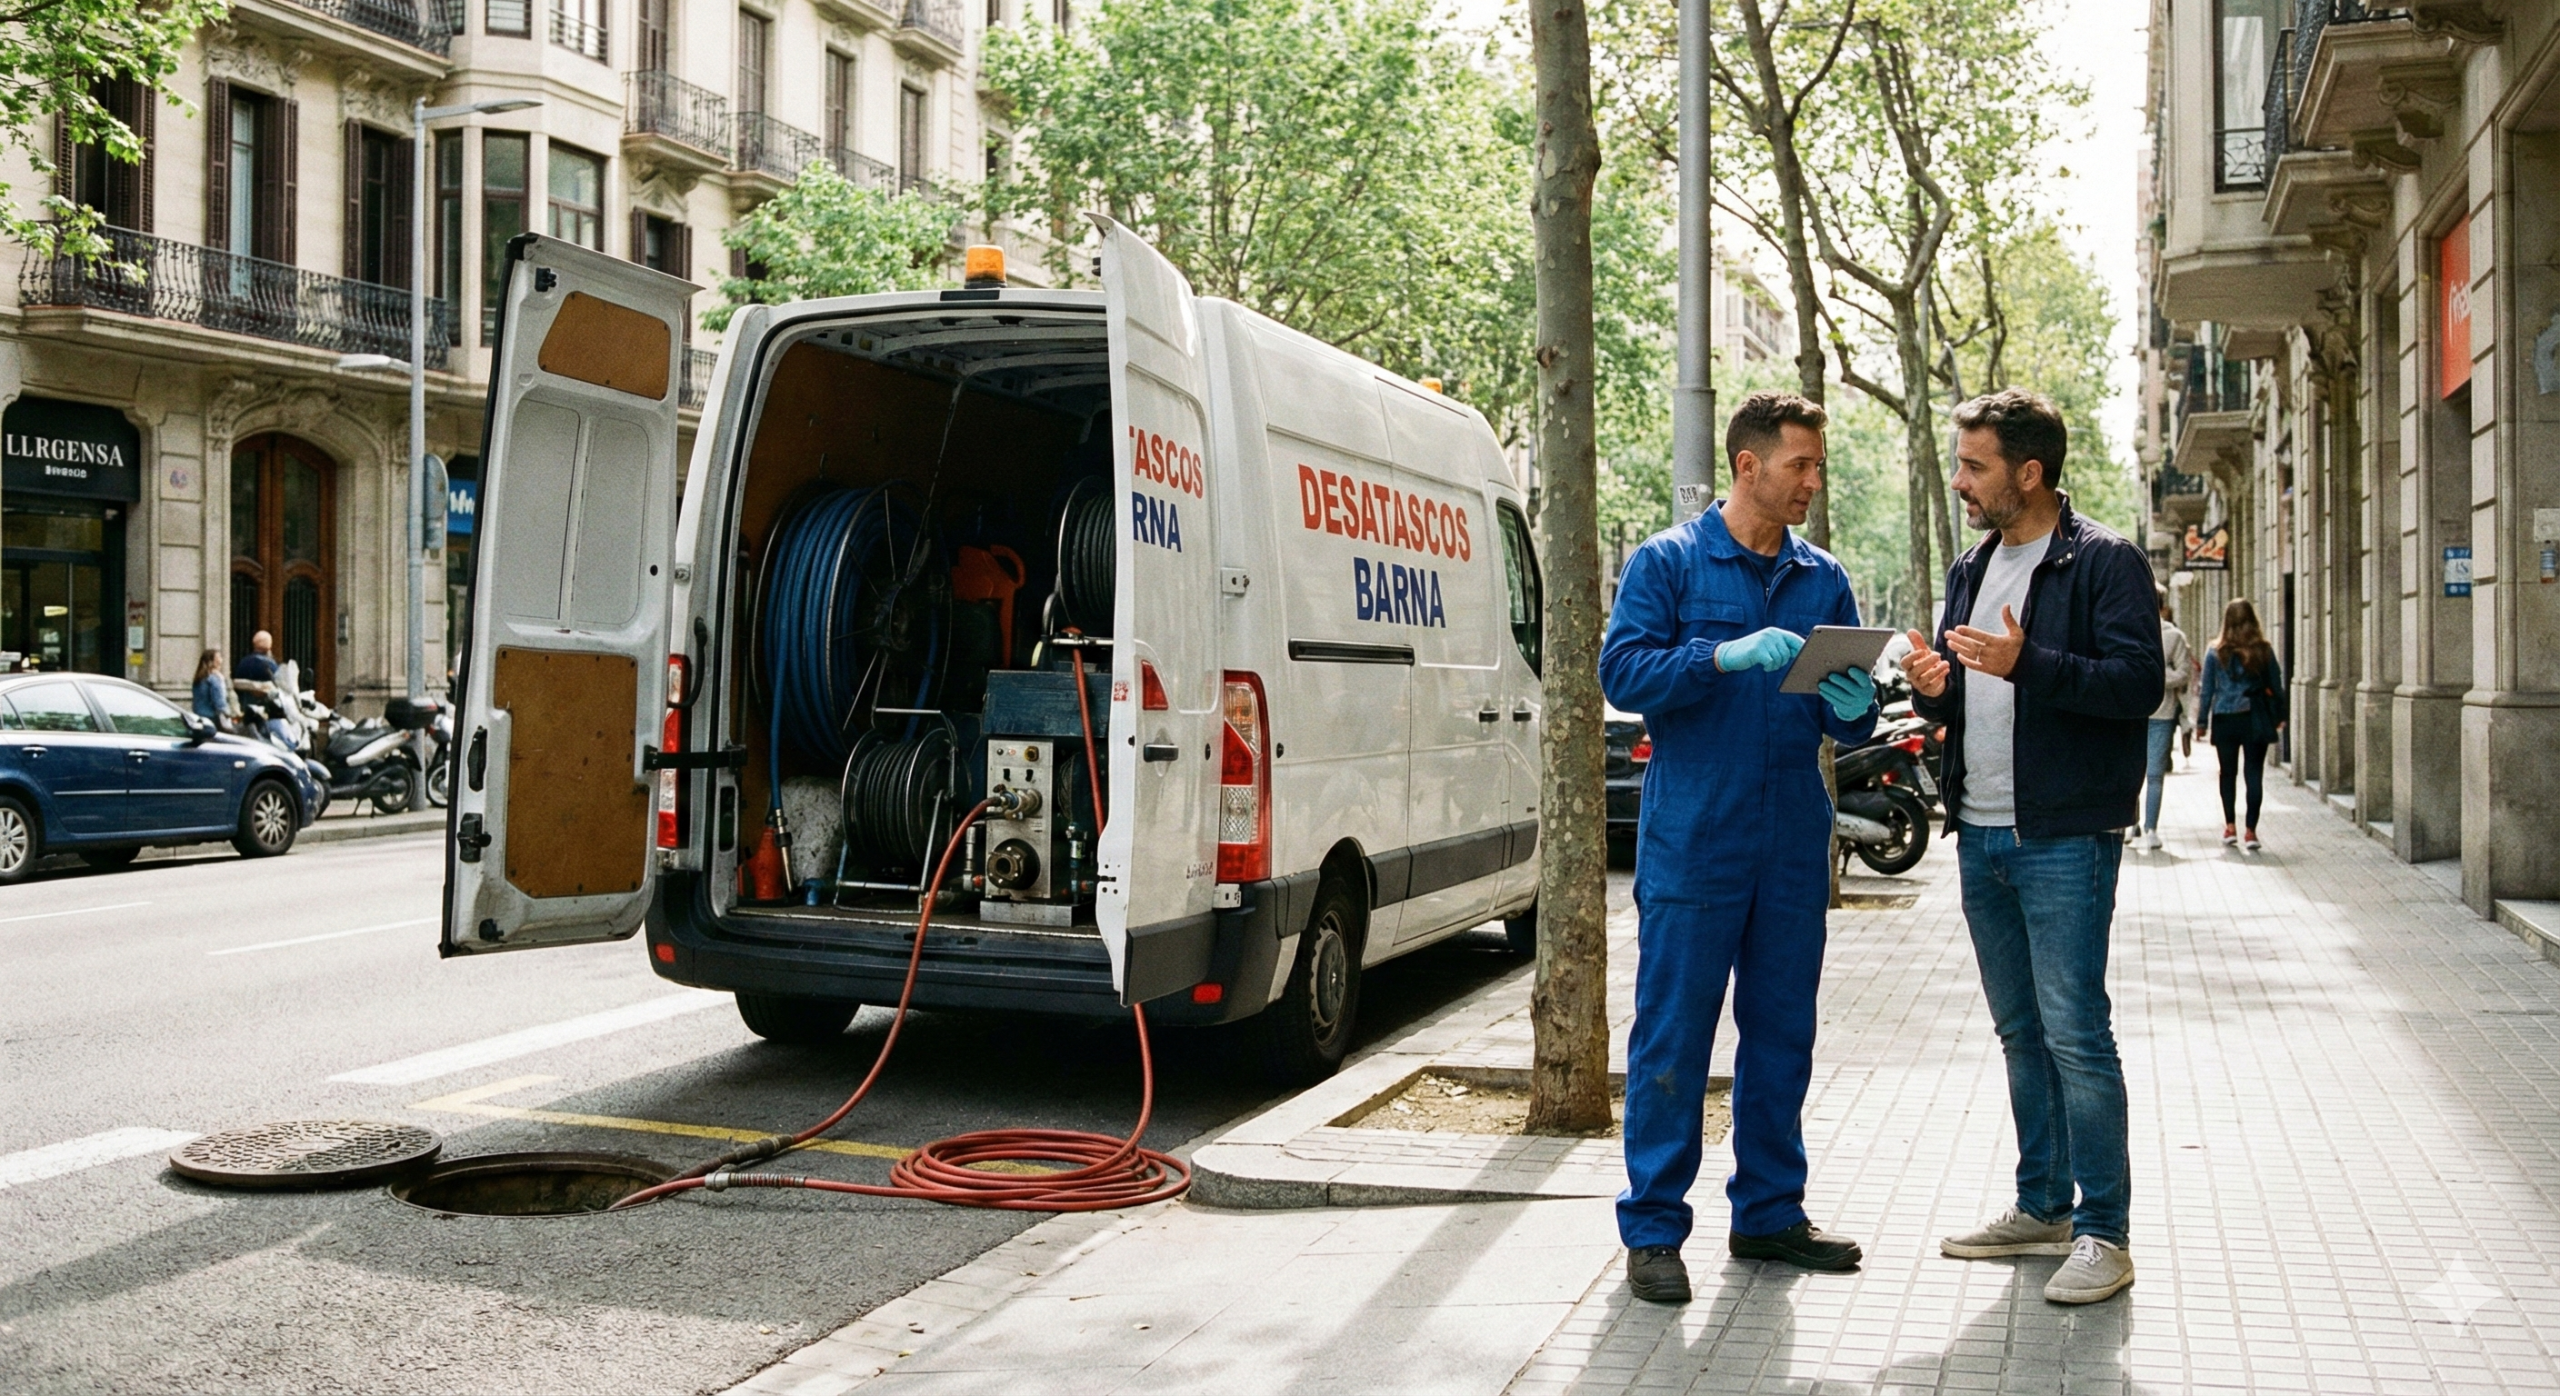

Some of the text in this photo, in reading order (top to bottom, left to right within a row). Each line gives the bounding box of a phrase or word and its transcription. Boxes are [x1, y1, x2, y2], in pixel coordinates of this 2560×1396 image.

[6, 433, 124, 467] LLRGENSA
[1131, 491, 1182, 553] RNA
[1298, 463, 1471, 562] DESATASCOS
[1354, 556, 1446, 628] BARNA
